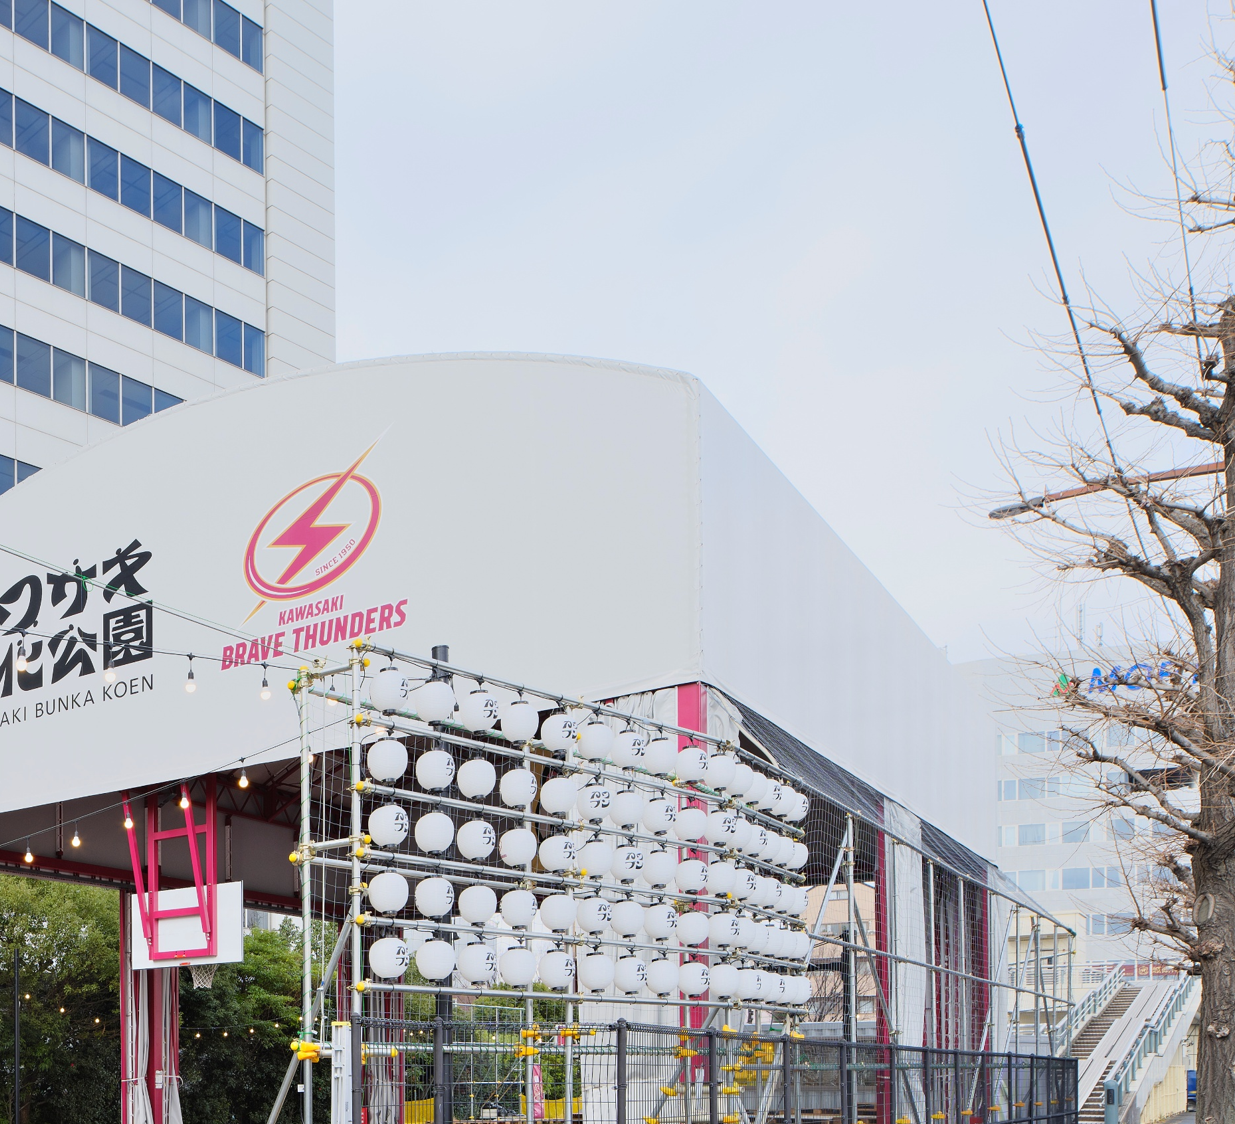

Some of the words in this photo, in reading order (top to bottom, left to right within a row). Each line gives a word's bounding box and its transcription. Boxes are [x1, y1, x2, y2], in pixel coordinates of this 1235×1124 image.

[315, 556, 339, 576] SINCE
[338, 538, 356, 559] 1950
[278, 594, 345, 627] KAWASAKI
[221, 631, 286, 671] BRAVE
[292, 598, 409, 654] THUNDERS
[35, 690, 95, 719] BUNKA
[102, 673, 154, 703] KOEN
